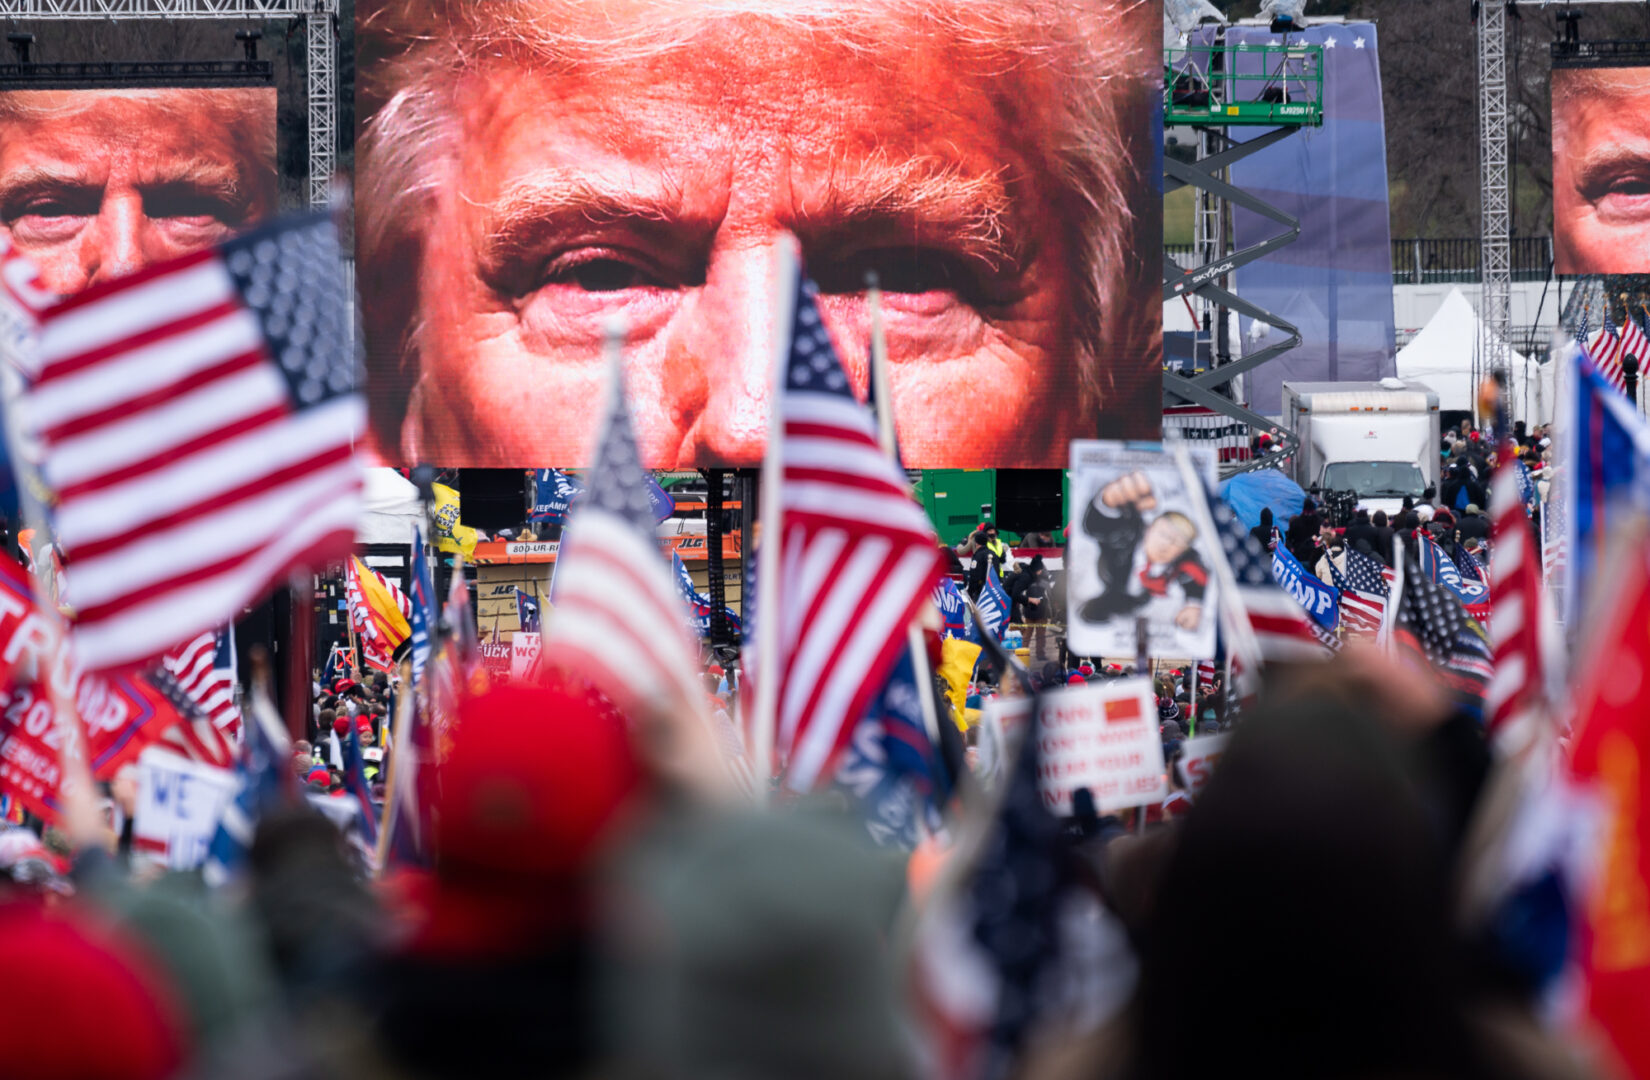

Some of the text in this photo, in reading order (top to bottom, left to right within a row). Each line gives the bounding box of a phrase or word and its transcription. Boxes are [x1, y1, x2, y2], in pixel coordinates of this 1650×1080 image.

[1192, 262, 1234, 283] SKYJACK
[677, 538, 703, 549] JLG
[491, 584, 515, 596] JLG
[1272, 554, 1332, 615] RUMP
[0, 734, 60, 788] ERICA
[151, 766, 196, 820] WE
